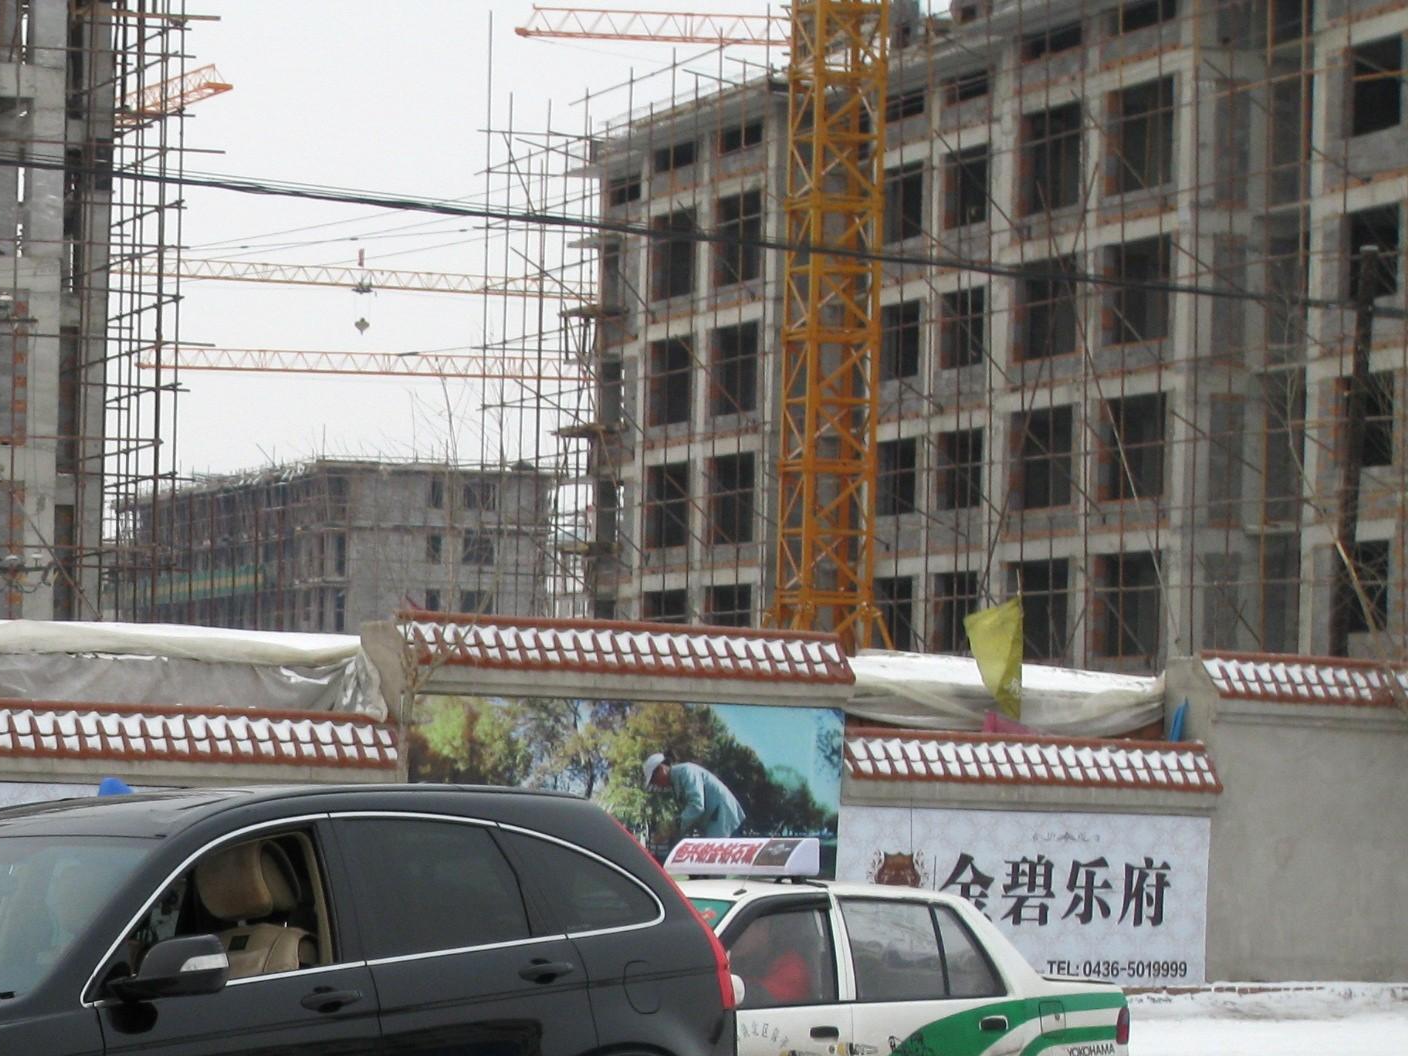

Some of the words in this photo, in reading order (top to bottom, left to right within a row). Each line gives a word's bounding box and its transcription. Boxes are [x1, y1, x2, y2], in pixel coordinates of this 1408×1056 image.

[938, 852, 1172, 927] 金碧乐府
[1046, 960, 1079, 976] TEL:
[1082, 961, 1188, 978] 0436-5019999
